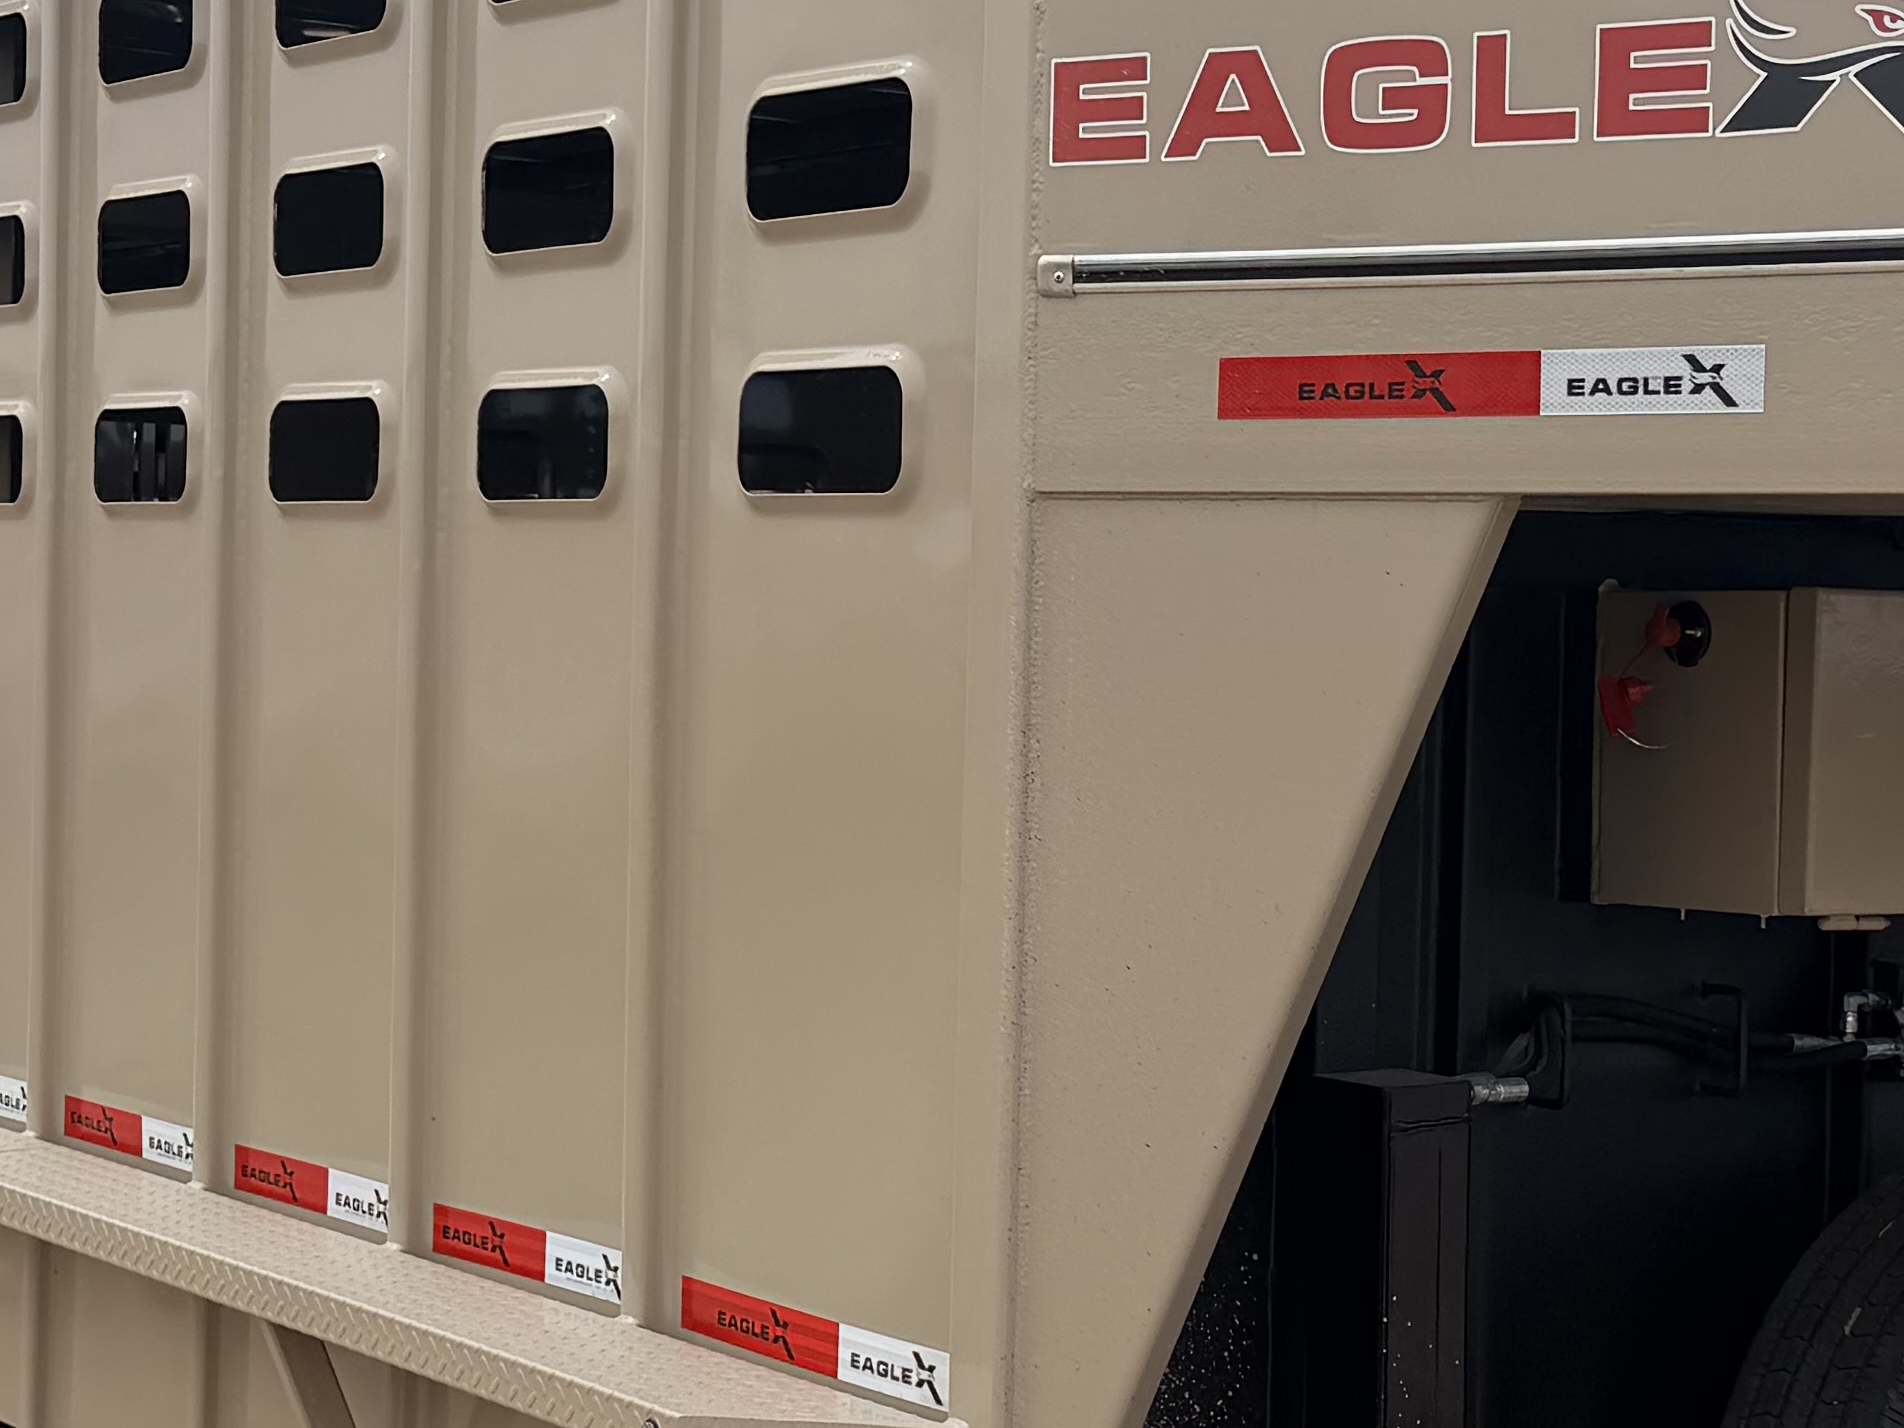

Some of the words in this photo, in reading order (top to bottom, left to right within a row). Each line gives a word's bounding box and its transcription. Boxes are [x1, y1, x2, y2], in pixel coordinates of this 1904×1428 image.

[1297, 359, 1457, 412] EAGLEX
[1566, 352, 1739, 407] EAGLEX
[240, 1159, 299, 1203] EAGLEX
[442, 1221, 510, 1268] EAGLEX
[554, 1253, 622, 1301] EAGLEX
[717, 1307, 795, 1362] EAGLEX
[849, 1350, 944, 1406] EAGLEX
